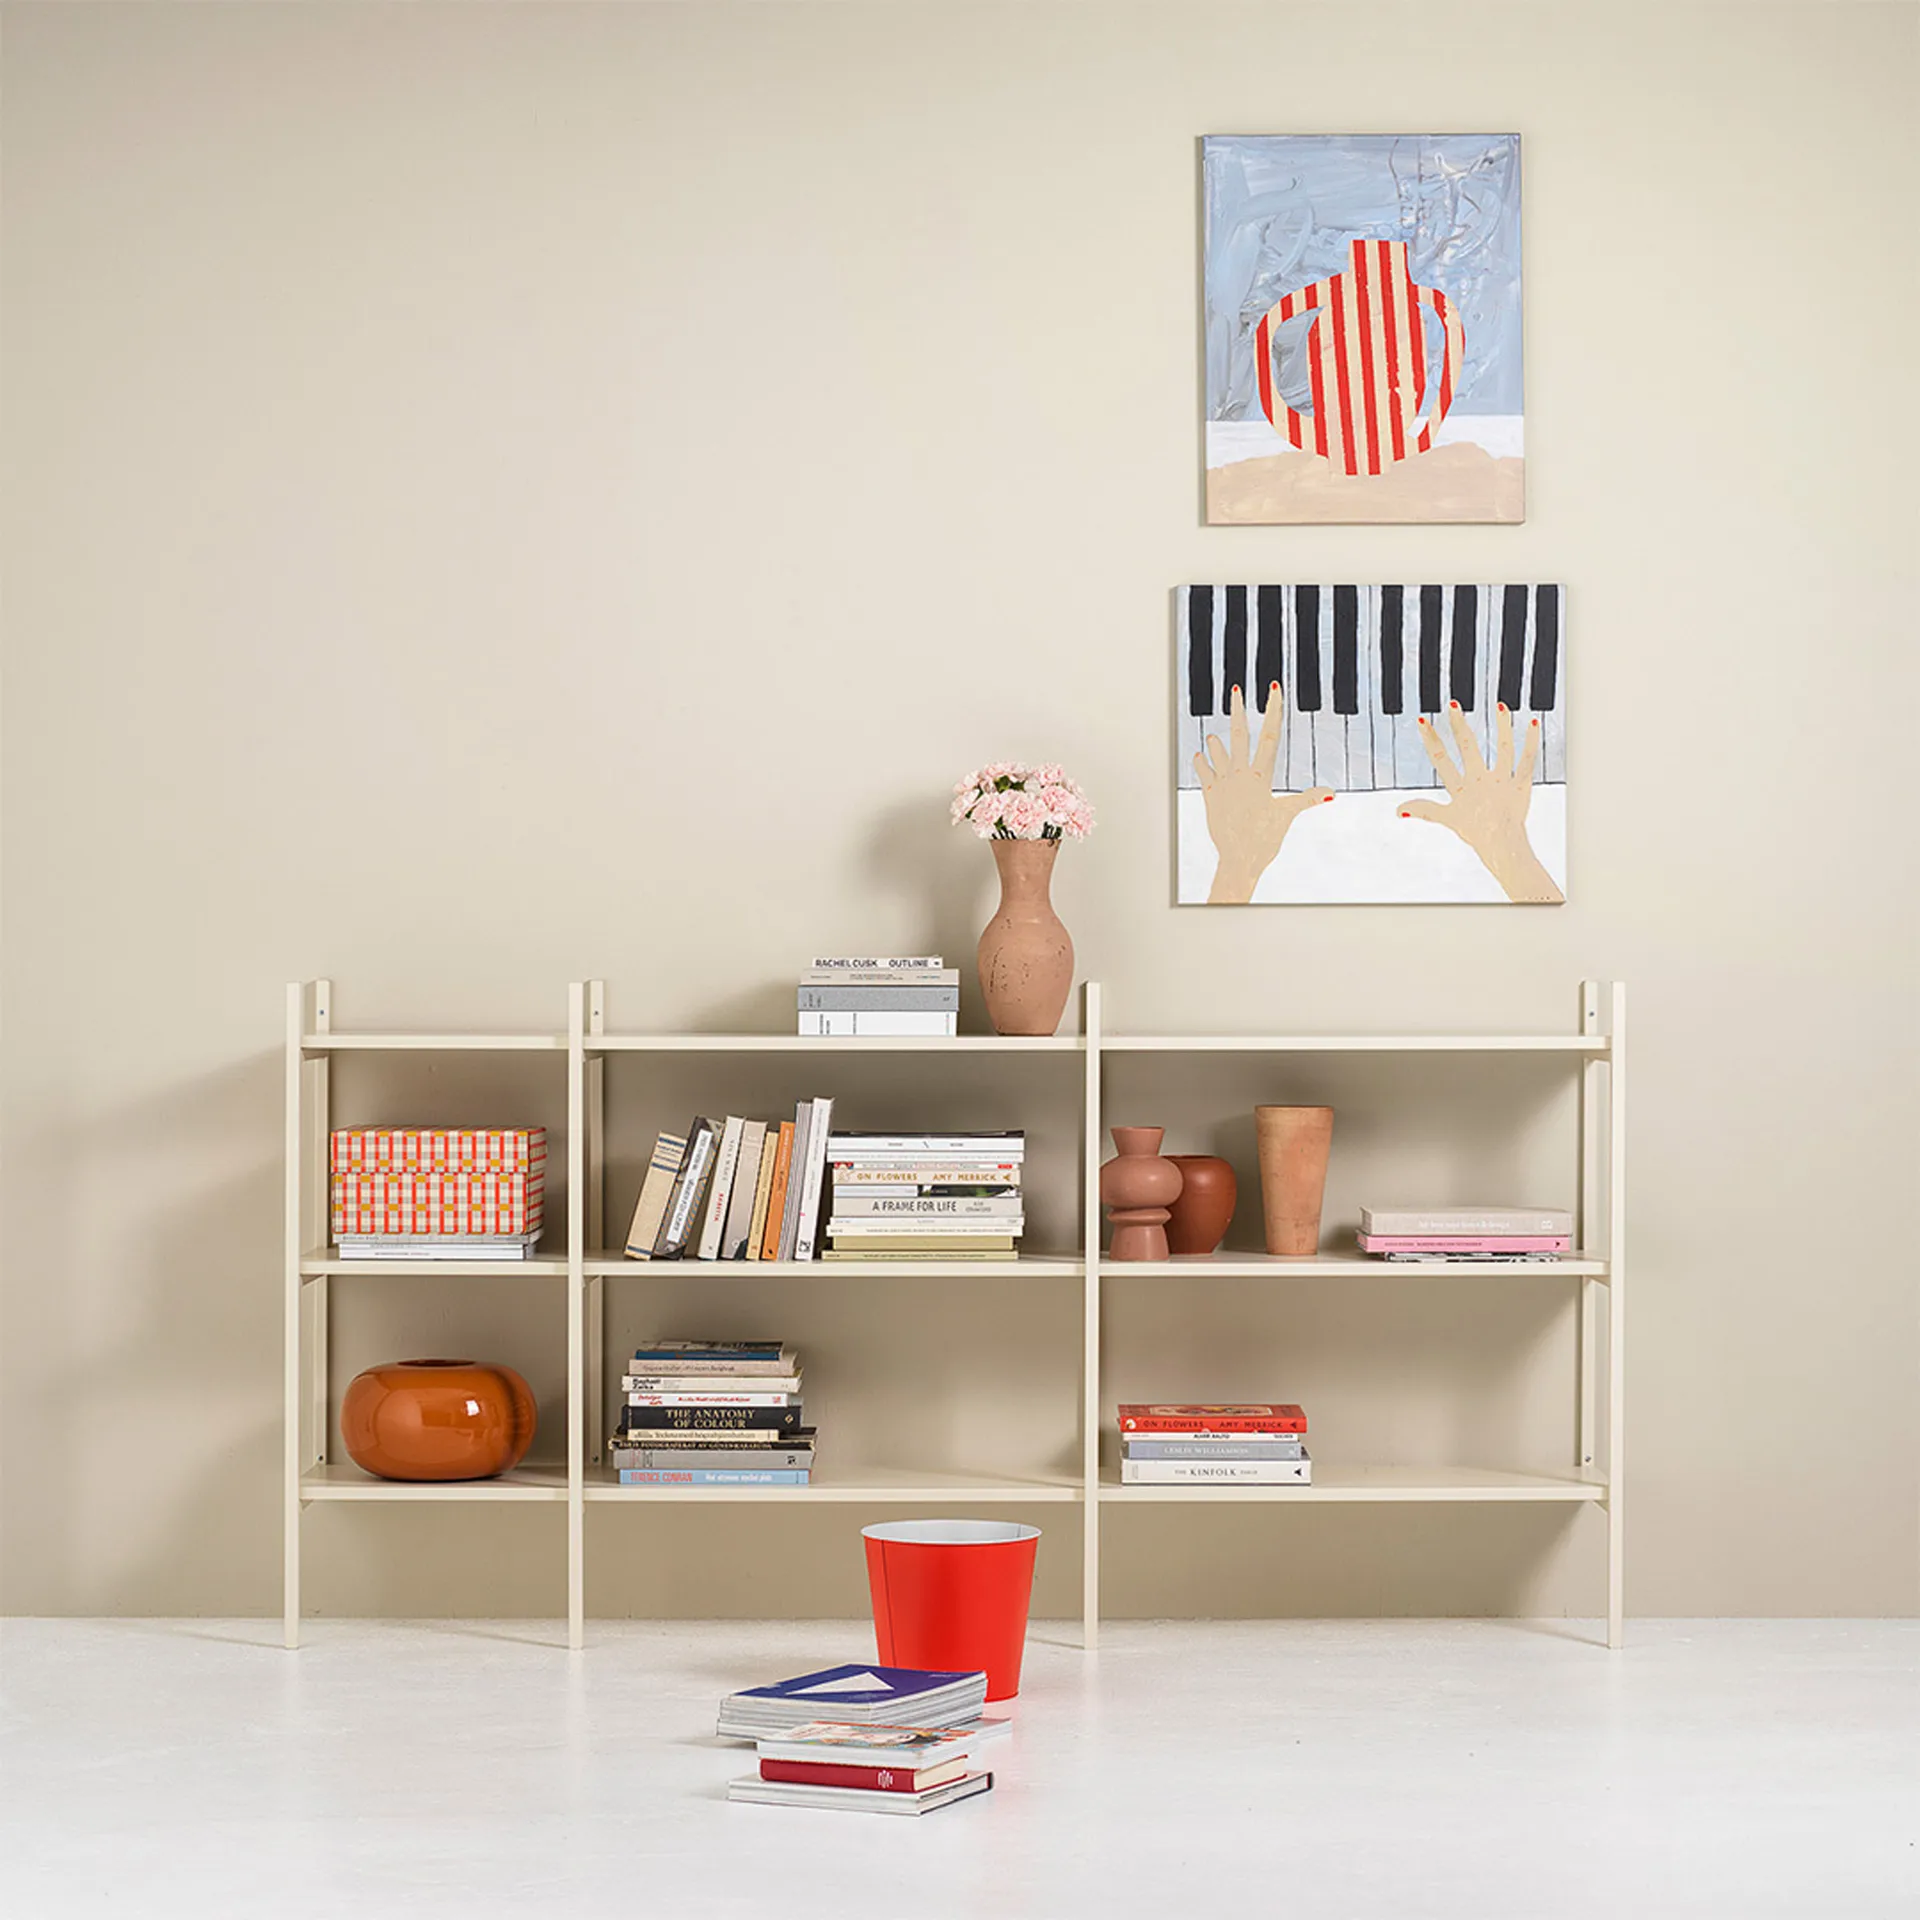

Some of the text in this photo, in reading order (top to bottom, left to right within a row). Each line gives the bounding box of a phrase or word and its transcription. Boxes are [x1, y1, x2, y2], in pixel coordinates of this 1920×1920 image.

[815, 958, 929, 968] RACHEL CUSK OUTLINE
[857, 1173, 997, 1181] ON FLOWERS AMY MERRICK
[872, 1201, 957, 1212] A FRAME FOR LIFE
[665, 1409, 755, 1418] THE ANATOMY
[673, 1419, 746, 1428] OF COLOUR
[1143, 1420, 1158, 1428] ON
[1163, 1420, 1204, 1428] FLOWERS
[1189, 1468, 1237, 1476] KINFOLK
[630, 1472, 693, 1482] TERENCE CONRAN
